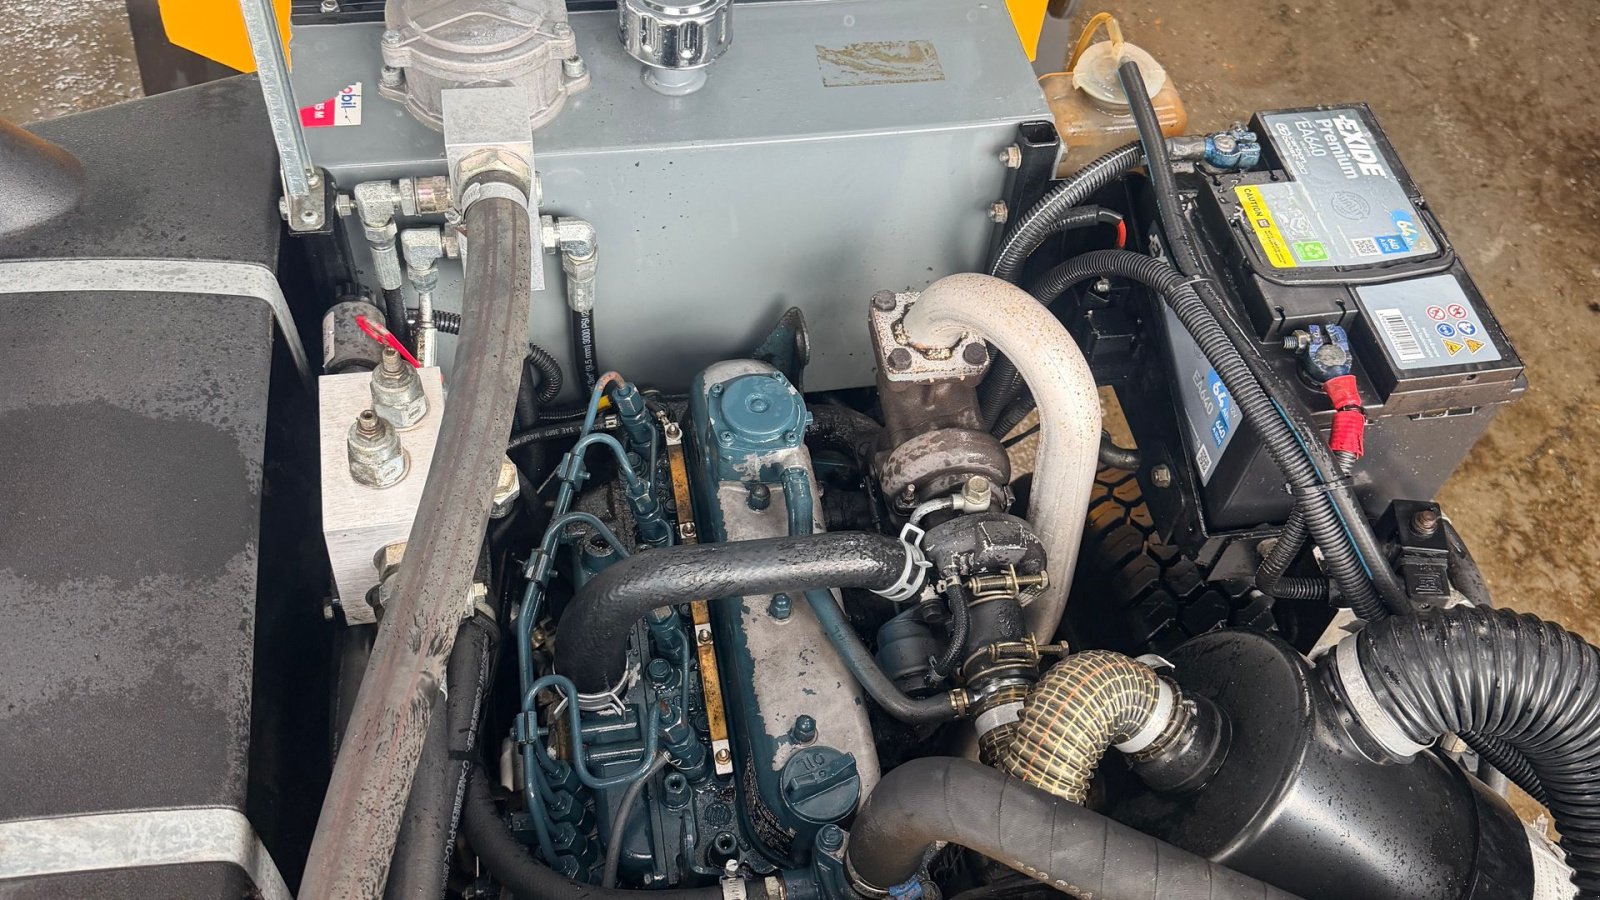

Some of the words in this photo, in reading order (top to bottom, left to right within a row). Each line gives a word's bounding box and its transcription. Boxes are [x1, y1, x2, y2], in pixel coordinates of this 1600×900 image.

[1294, 120, 1327, 157] EA640
[1315, 118, 1360, 179] Premium
[1332, 114, 1387, 178] EXIDE
[1244, 188, 1264, 217] CAUTION
[1396, 220, 1418, 237] 64
[580, 318, 590, 328] PSI
[582, 328, 592, 344] 3000
[1192, 369, 1214, 415] EA640
[802, 752, 826, 772] OIL
